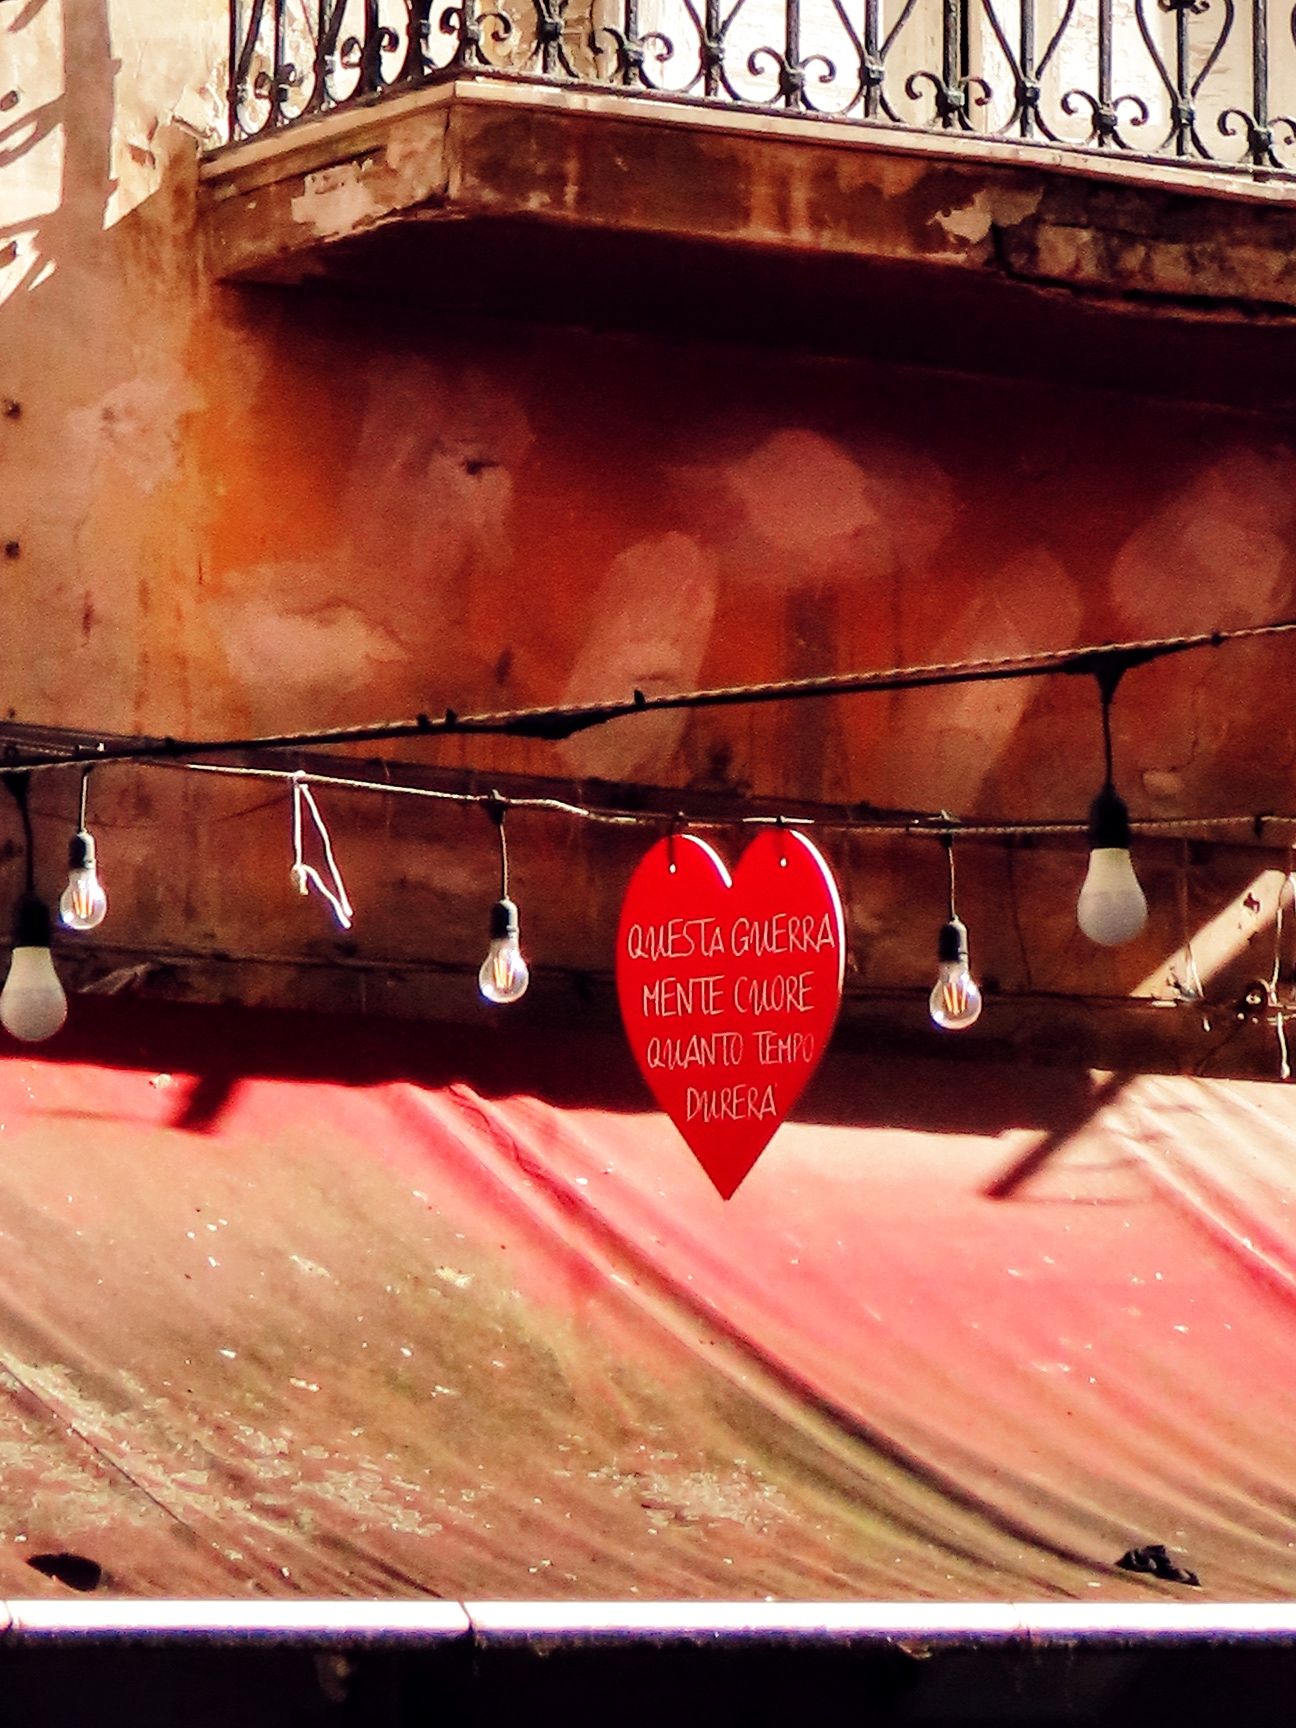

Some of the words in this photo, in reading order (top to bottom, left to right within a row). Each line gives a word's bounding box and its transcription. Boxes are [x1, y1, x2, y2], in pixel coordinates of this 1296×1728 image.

[627, 918, 725, 961] QUESTA
[731, 913, 836, 957] GUERRA
[643, 975, 725, 1017] MENTE
[734, 971, 814, 1015] CUORE
[647, 1032, 744, 1070] QUANTO
[752, 1030, 815, 1064] TEMPO
